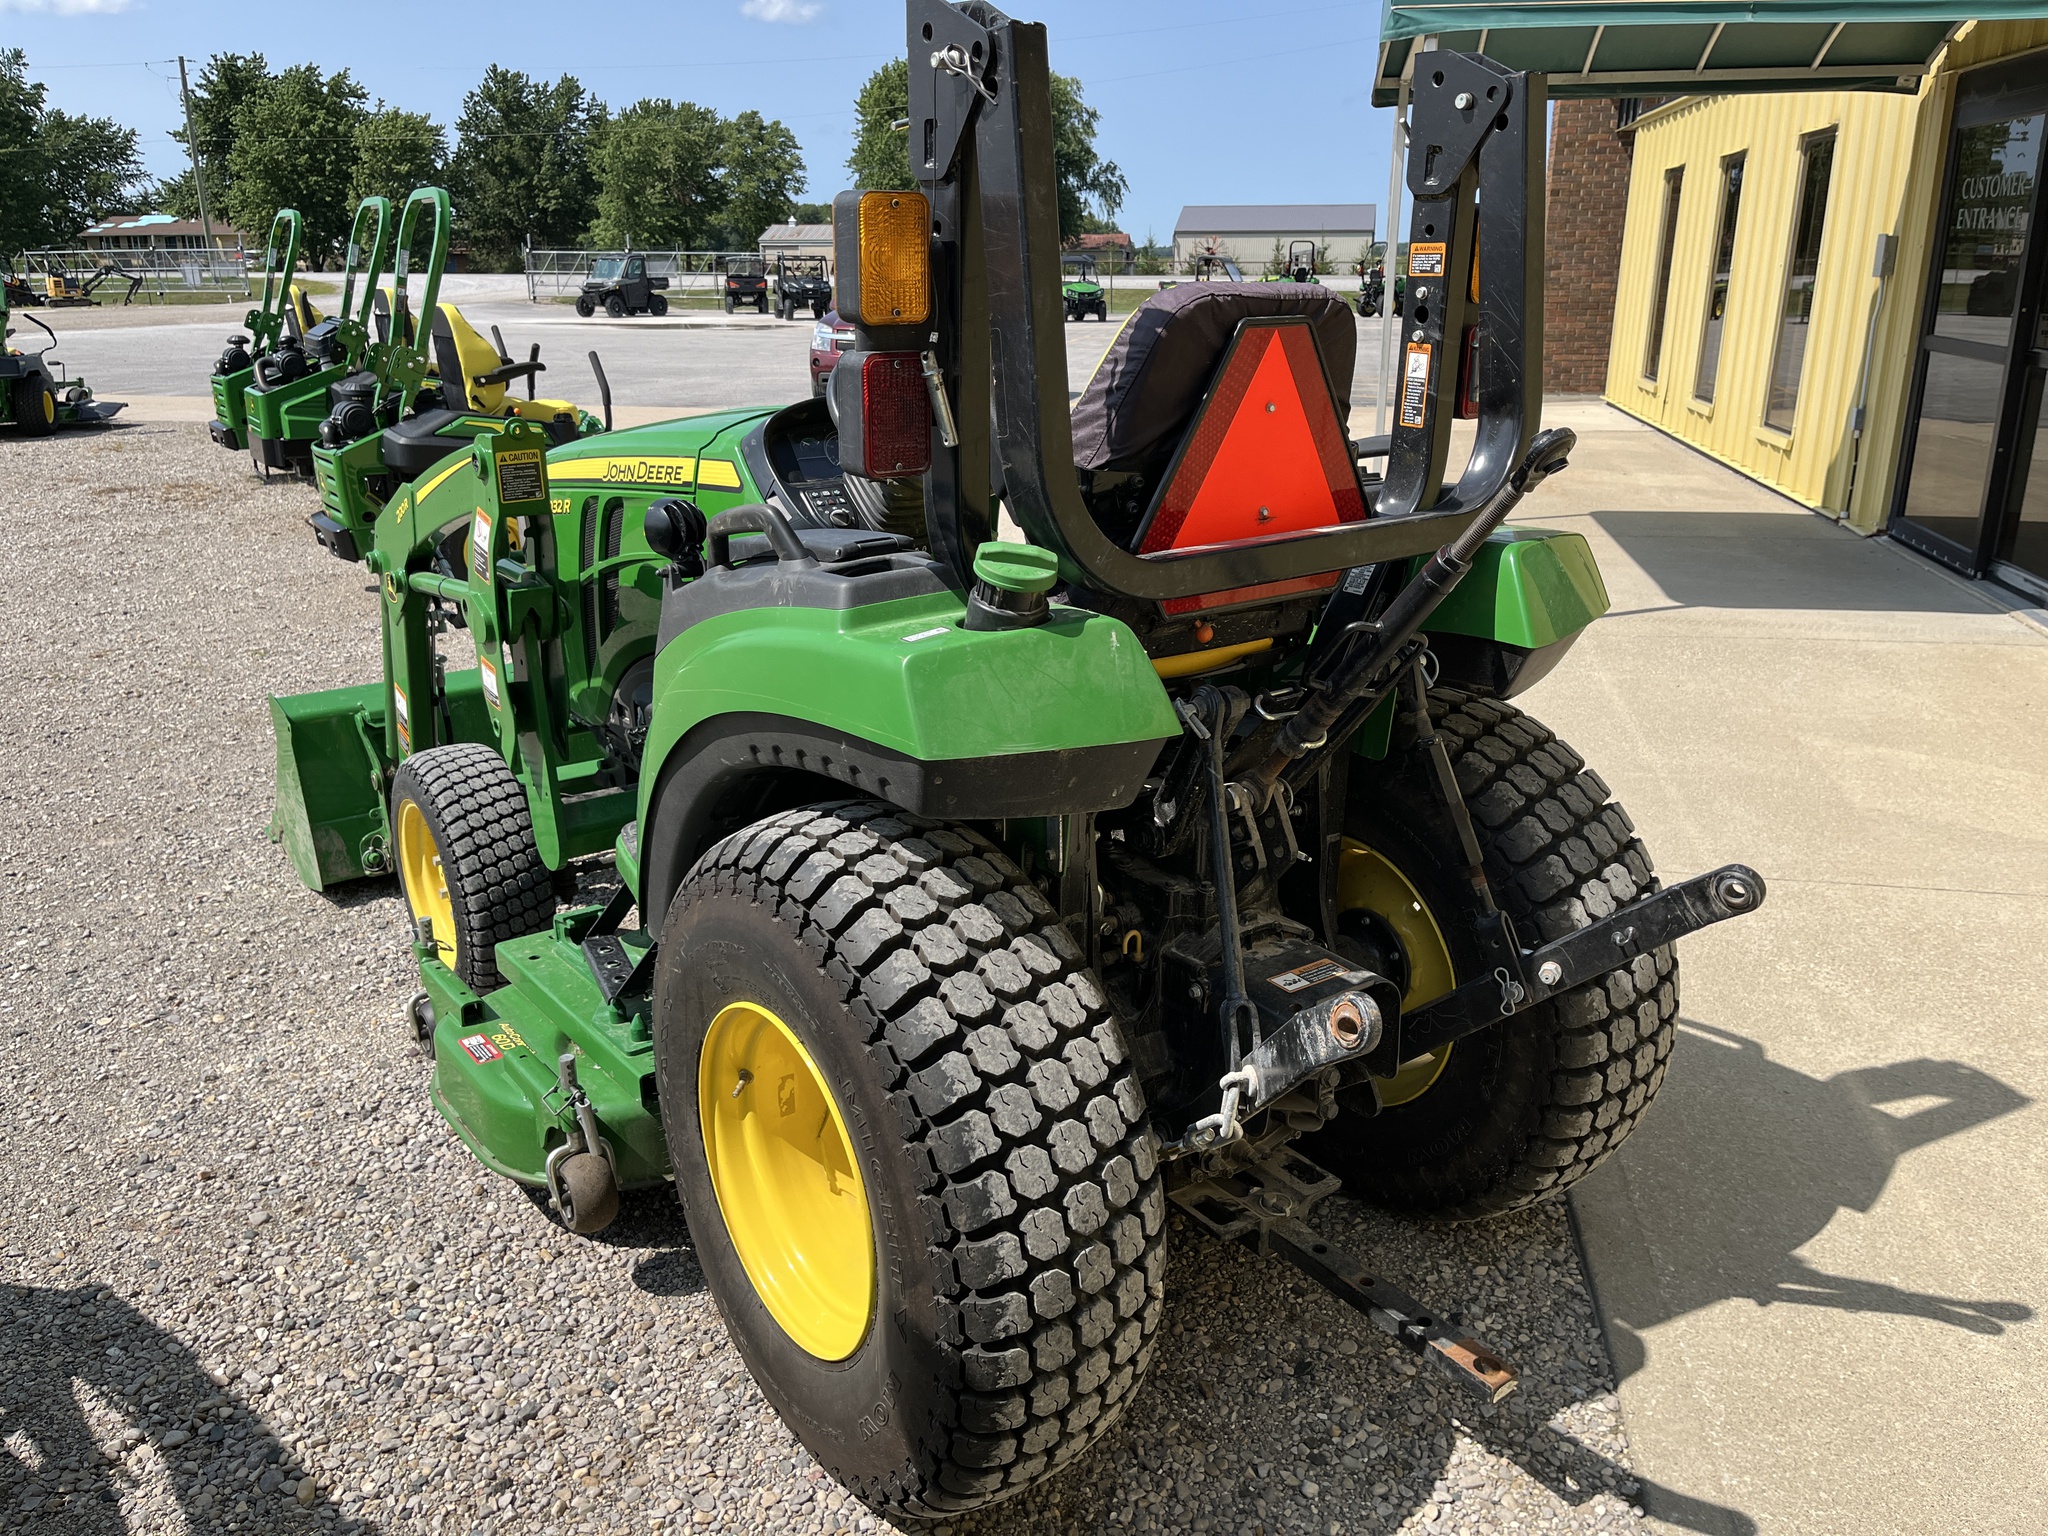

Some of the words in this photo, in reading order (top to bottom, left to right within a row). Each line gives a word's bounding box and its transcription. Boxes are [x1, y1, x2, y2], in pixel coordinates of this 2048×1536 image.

[1961, 172, 2026, 199] CUSTOMER
[1956, 206, 2023, 230] ENTRANCE
[508, 451, 539, 462] CAUTION
[602, 461, 636, 479] JOHN
[636, 461, 684, 482] DEERE
[550, 499, 571, 514] 32R
[491, 1034, 516, 1050] 60D
[856, 1368, 903, 1443] MOW
